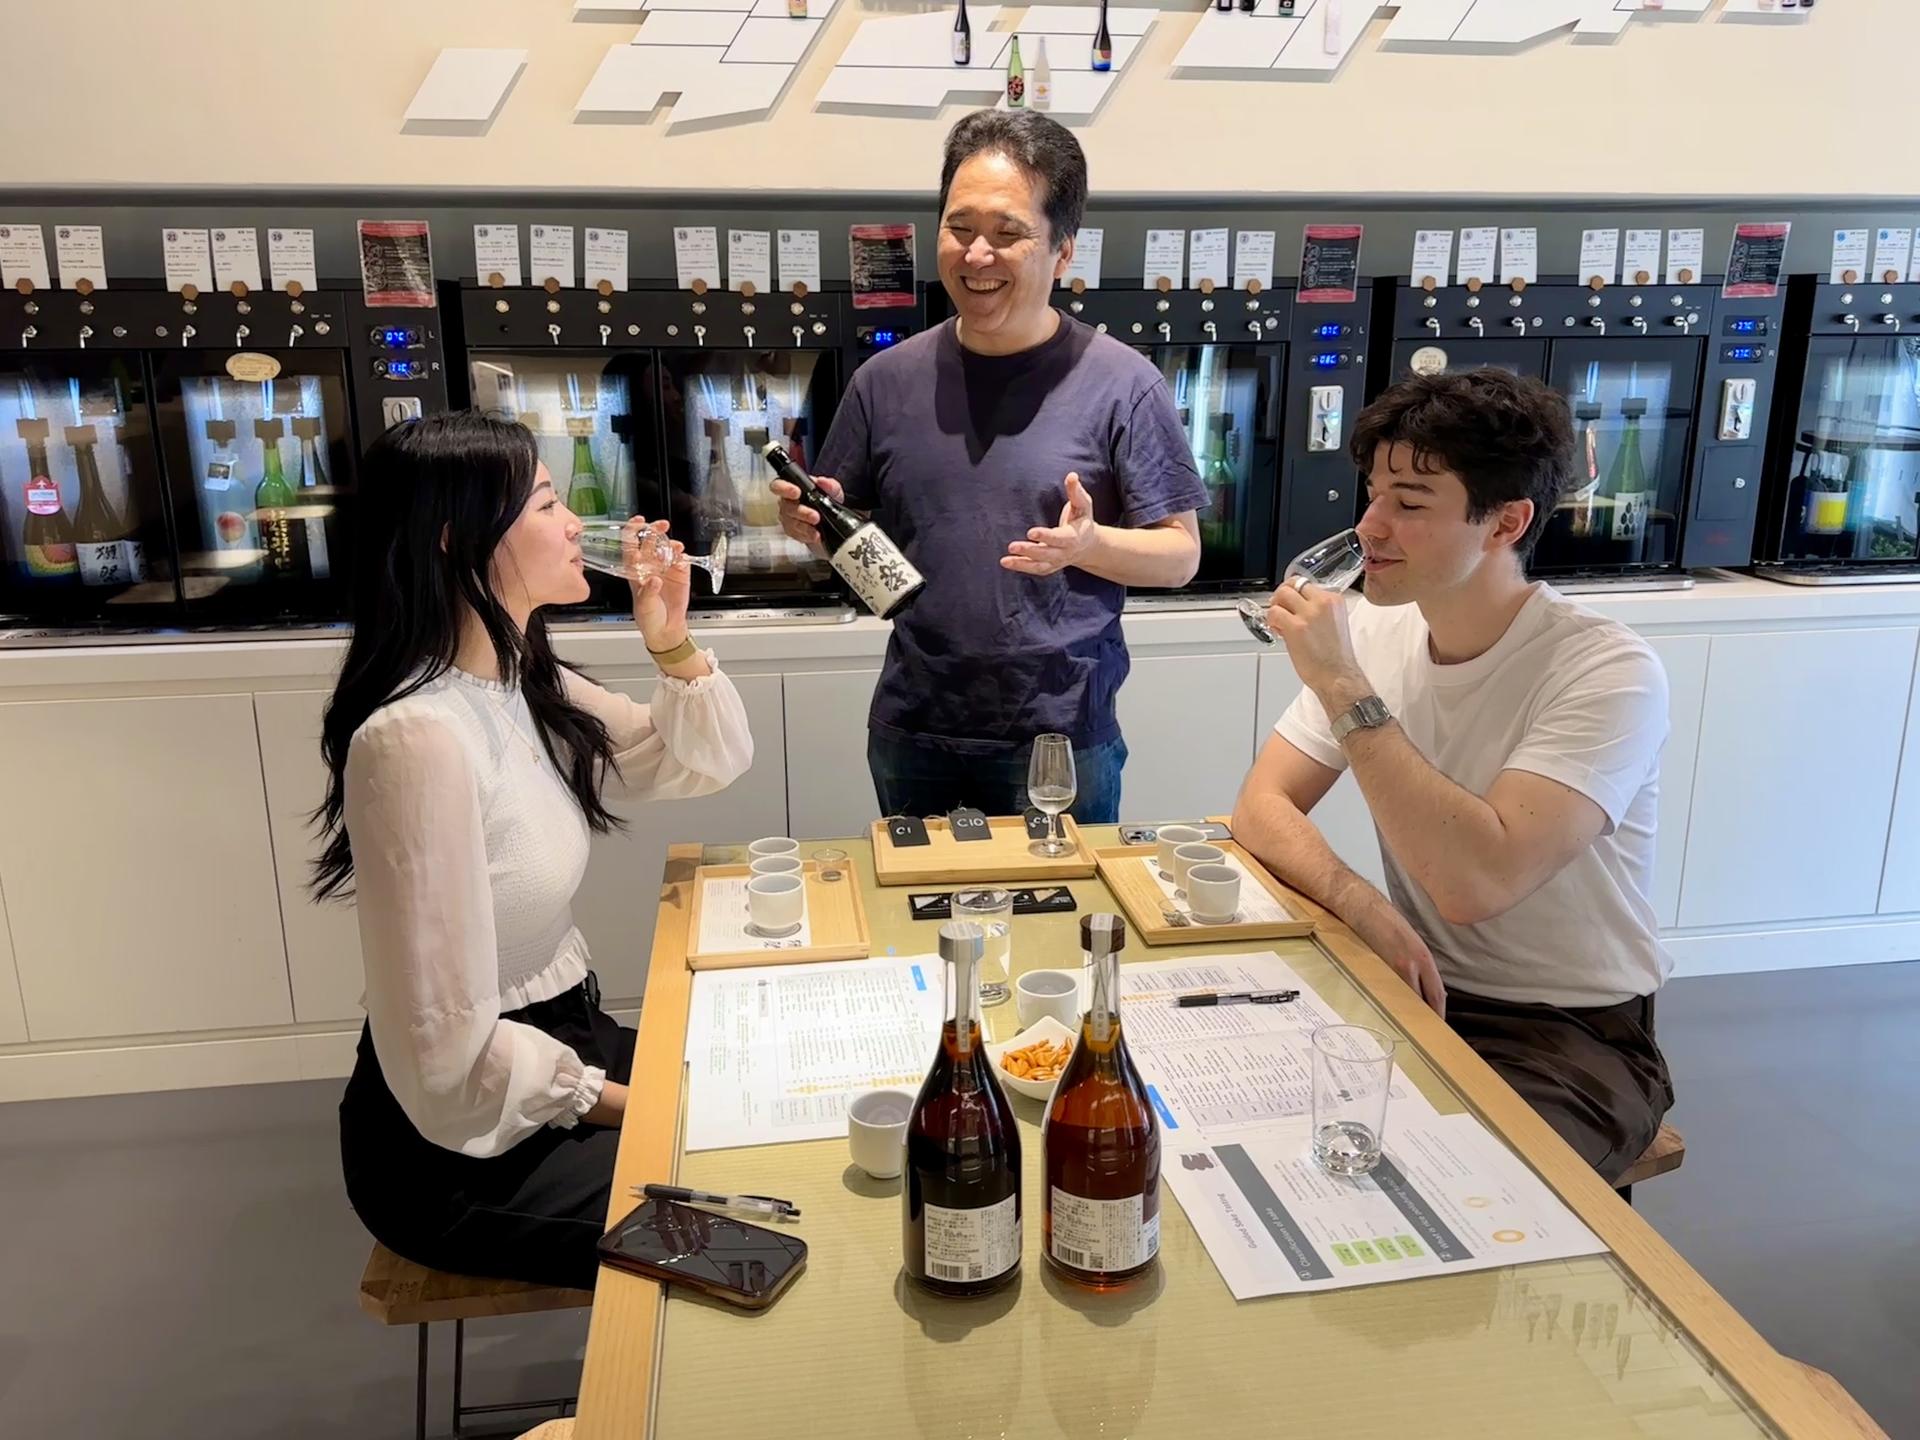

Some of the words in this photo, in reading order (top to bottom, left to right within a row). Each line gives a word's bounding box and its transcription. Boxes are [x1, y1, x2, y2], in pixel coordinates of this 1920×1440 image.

[428, 330, 435, 339] L
[1359, 326, 1365, 334] L
[1356, 355, 1363, 364] R
[432, 362, 440, 371] R
[956, 818, 984, 828] C10
[896, 826, 912, 836] C1
[1216, 1192, 1234, 1213] Tasting
[1398, 1191, 1422, 1215] polishing
[1230, 1213, 1245, 1229] Sake
[1419, 1215, 1431, 1228] rice
[1239, 1227, 1257, 1249] Guided
[1431, 1232, 1450, 1249] What
[1279, 1227, 1311, 1267] Classification
